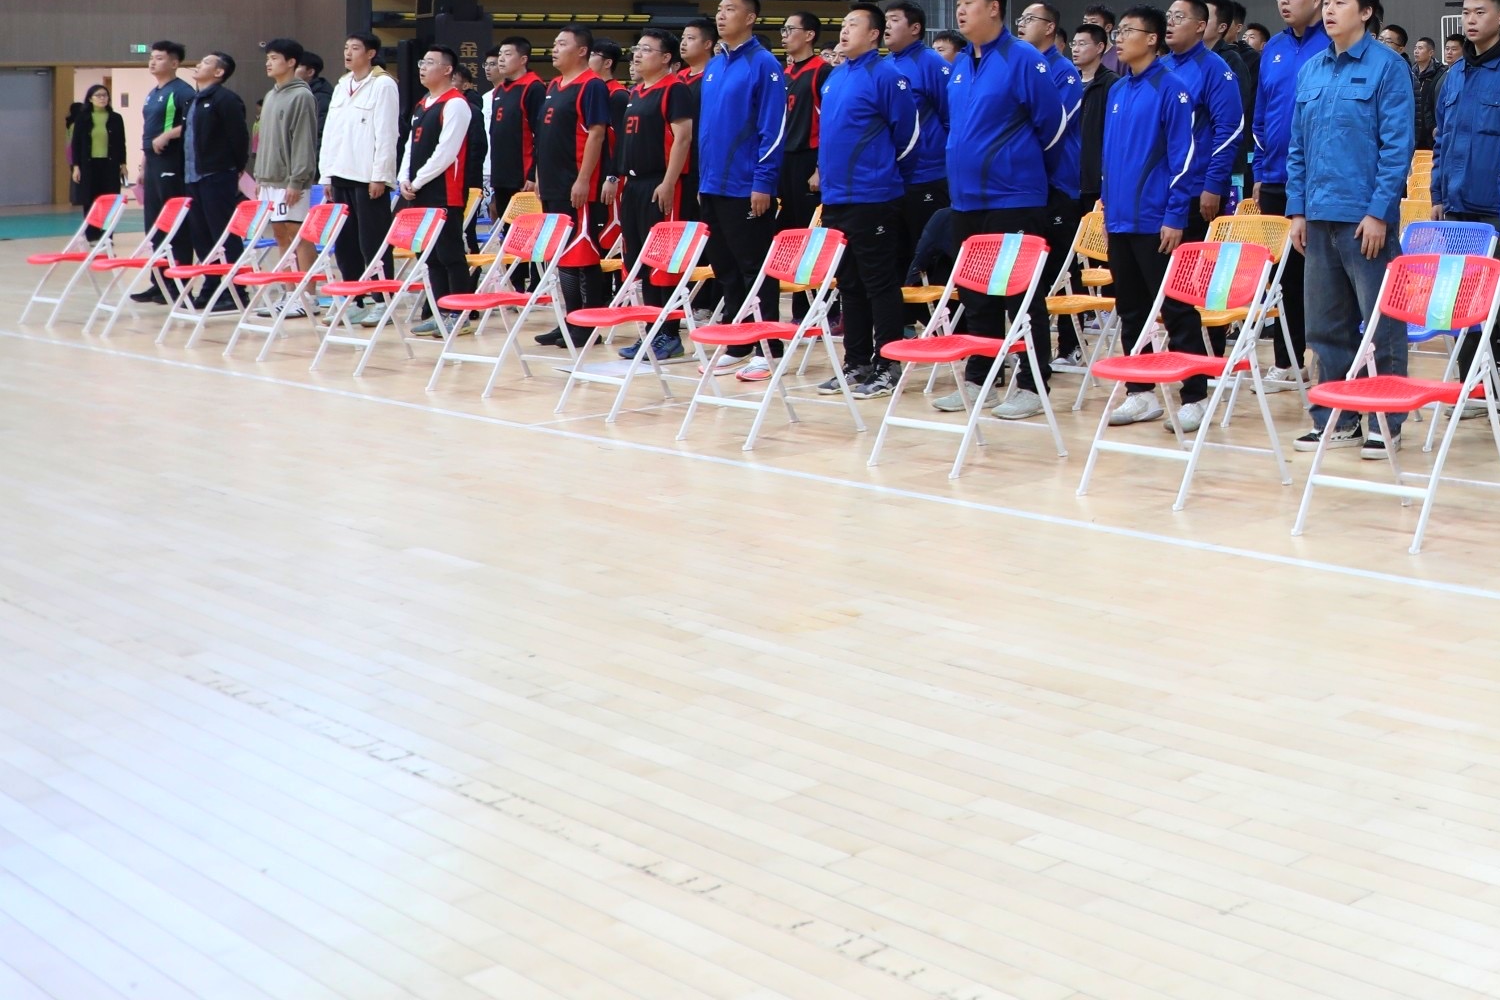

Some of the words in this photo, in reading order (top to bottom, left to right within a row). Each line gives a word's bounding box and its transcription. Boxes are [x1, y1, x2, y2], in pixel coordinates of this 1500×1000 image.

[544, 107, 554, 124] 2
[626, 116, 640, 133] 27
[413, 126, 423, 142] 9
